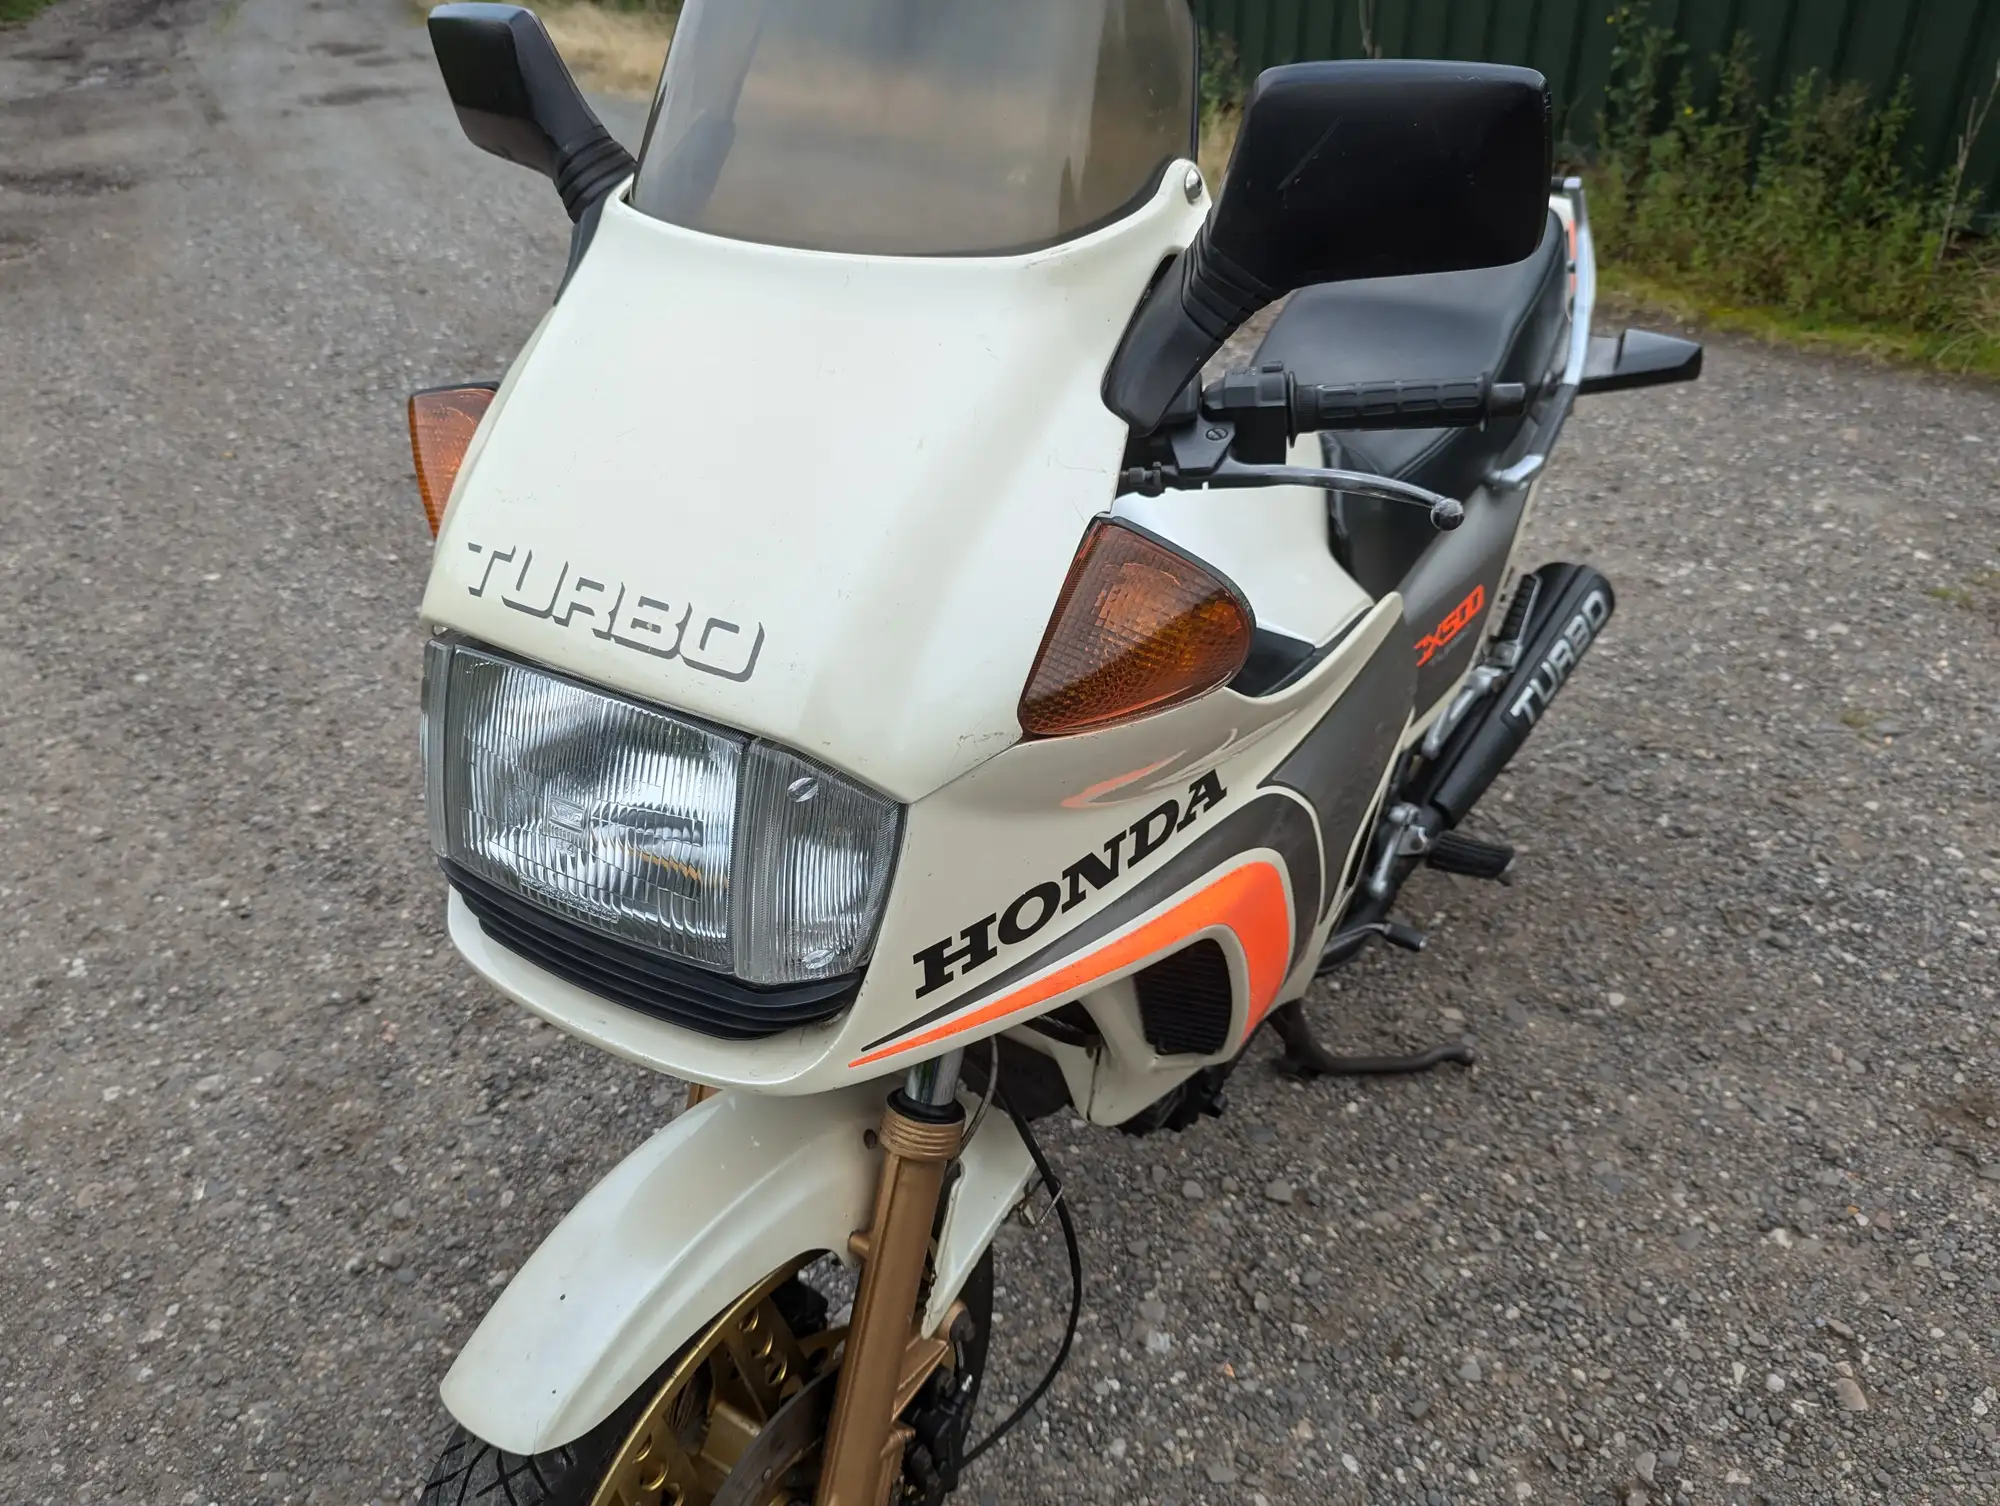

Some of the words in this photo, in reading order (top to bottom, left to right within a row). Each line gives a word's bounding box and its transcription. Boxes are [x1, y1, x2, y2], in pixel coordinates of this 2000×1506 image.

[468, 542, 764, 682] TURBO
[1510, 590, 1606, 724] TURBO
[912, 769, 1228, 1000] HONDA
